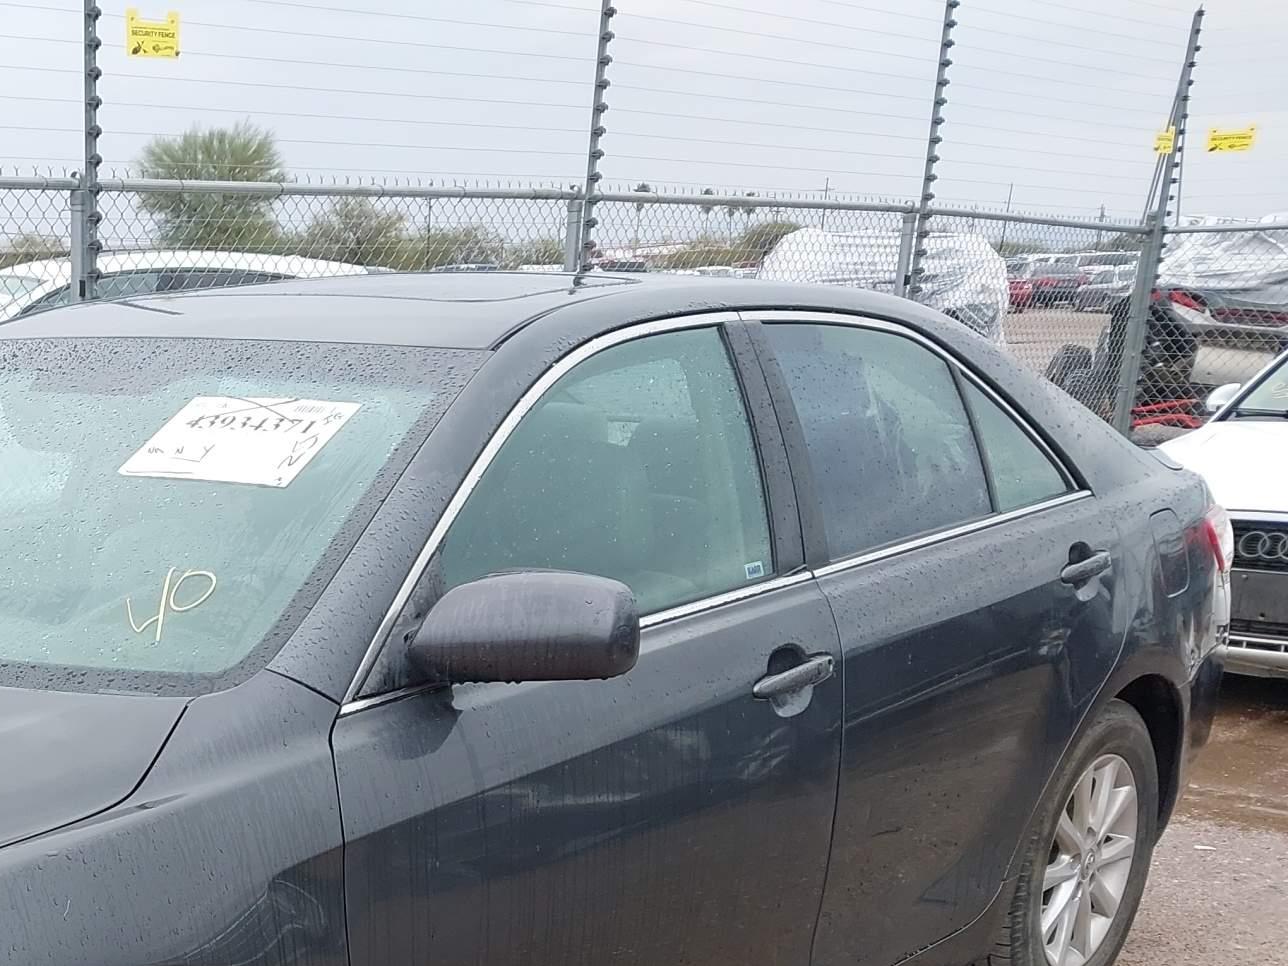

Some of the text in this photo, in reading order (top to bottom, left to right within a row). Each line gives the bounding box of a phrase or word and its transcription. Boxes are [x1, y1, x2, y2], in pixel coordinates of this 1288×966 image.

[131, 29, 176, 39] SECURITY FENCE
[185, 411, 317, 434] 43934371
[126, 566, 217, 642] 40
